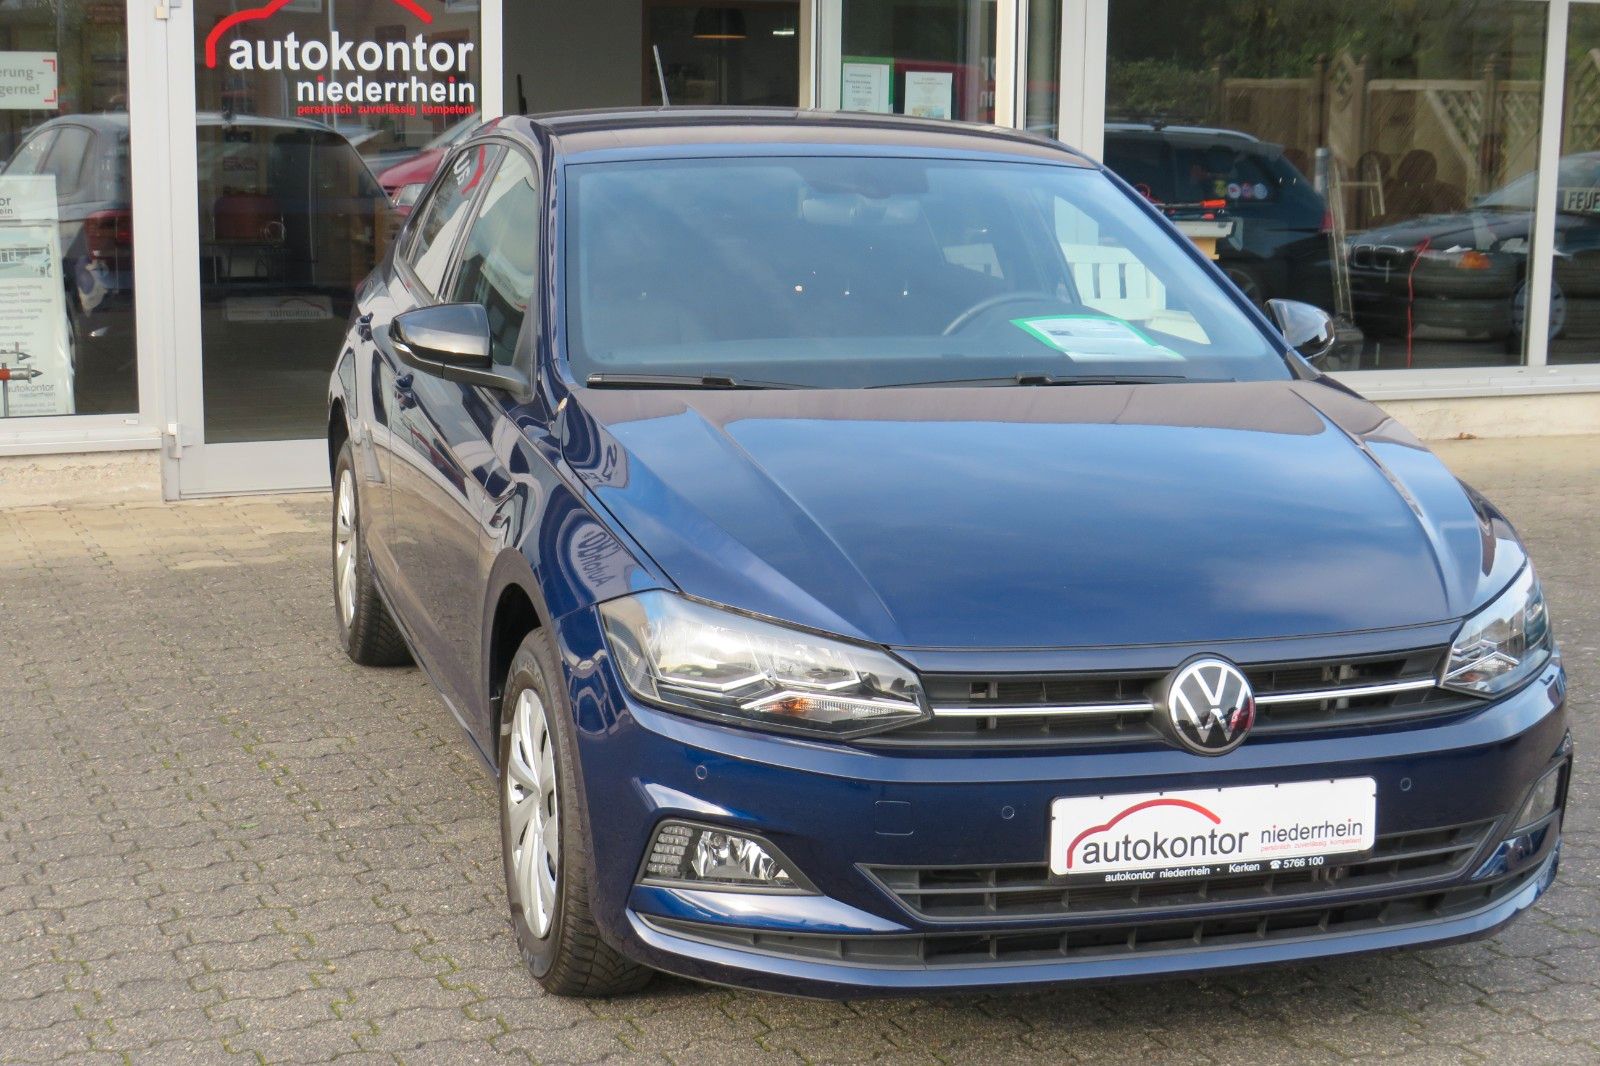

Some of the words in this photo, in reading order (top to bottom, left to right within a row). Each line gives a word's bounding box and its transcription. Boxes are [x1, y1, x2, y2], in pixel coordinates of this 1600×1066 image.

[229, 31, 475, 71] autokontor
[297, 76, 475, 103] niederrhein
[358, 104, 416, 116] zuverlässig
[421, 105, 475, 115] kompetent
[1261, 819, 1363, 844] niederrhein
[1082, 828, 1249, 864] autokontor
[1105, 870, 1155, 882] autokontor
[1159, 866, 1211, 878] niederrhein
[1229, 862, 1260, 873] Kerken
[1308, 856, 1324, 866] 100
